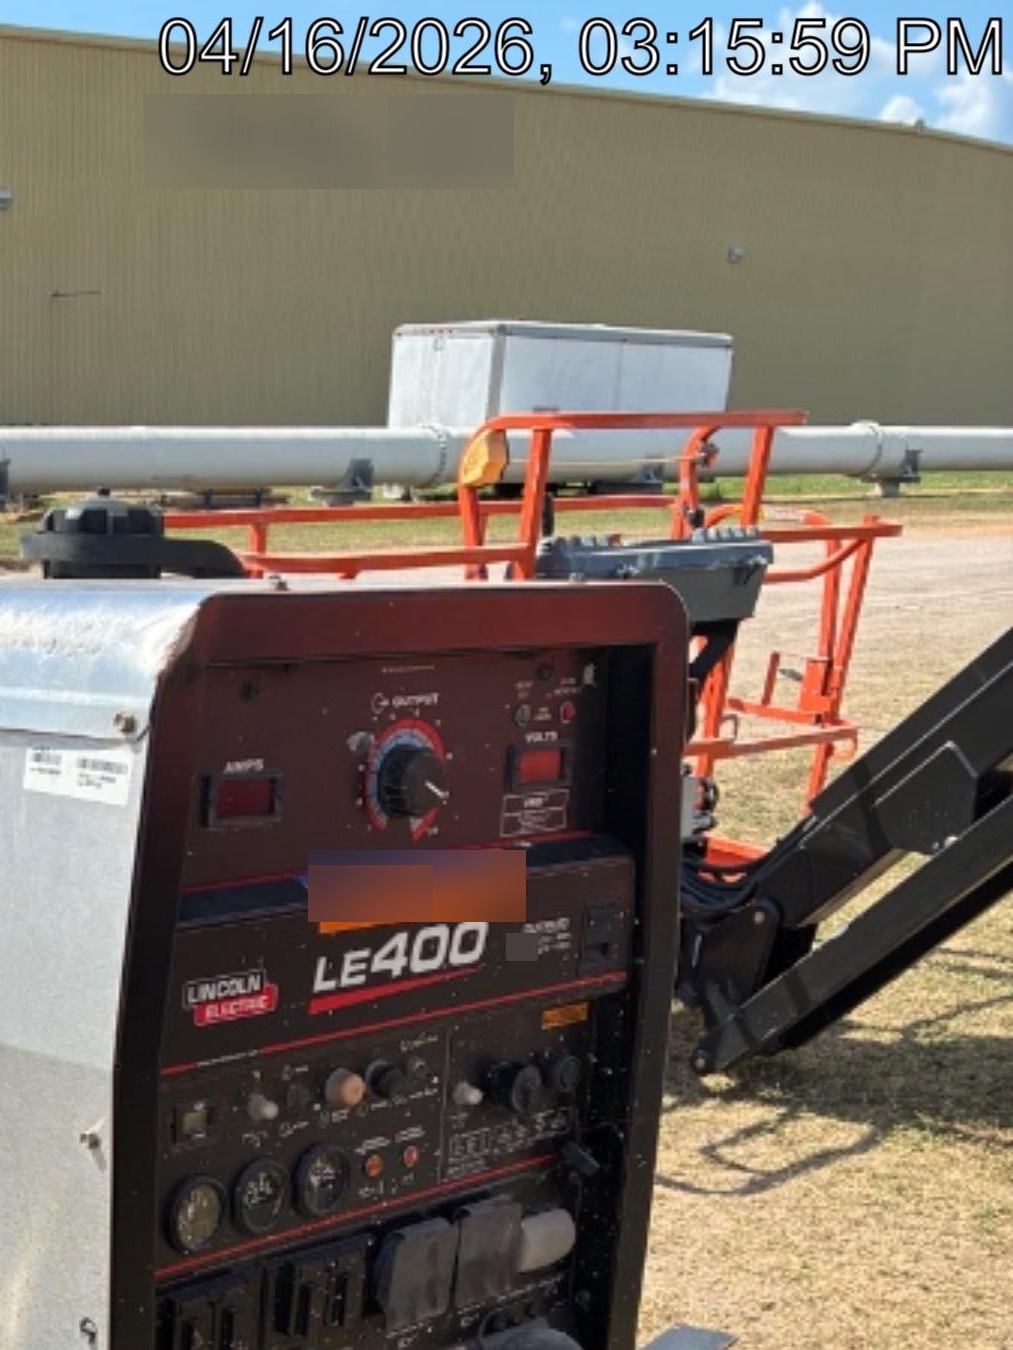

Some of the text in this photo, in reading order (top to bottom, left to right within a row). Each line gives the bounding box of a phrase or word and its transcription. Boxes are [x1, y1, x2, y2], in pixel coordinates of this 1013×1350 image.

[223, 758, 264, 775] AMPS
[312, 921, 489, 995] LE400
[188, 973, 262, 1004] LINCOLN
